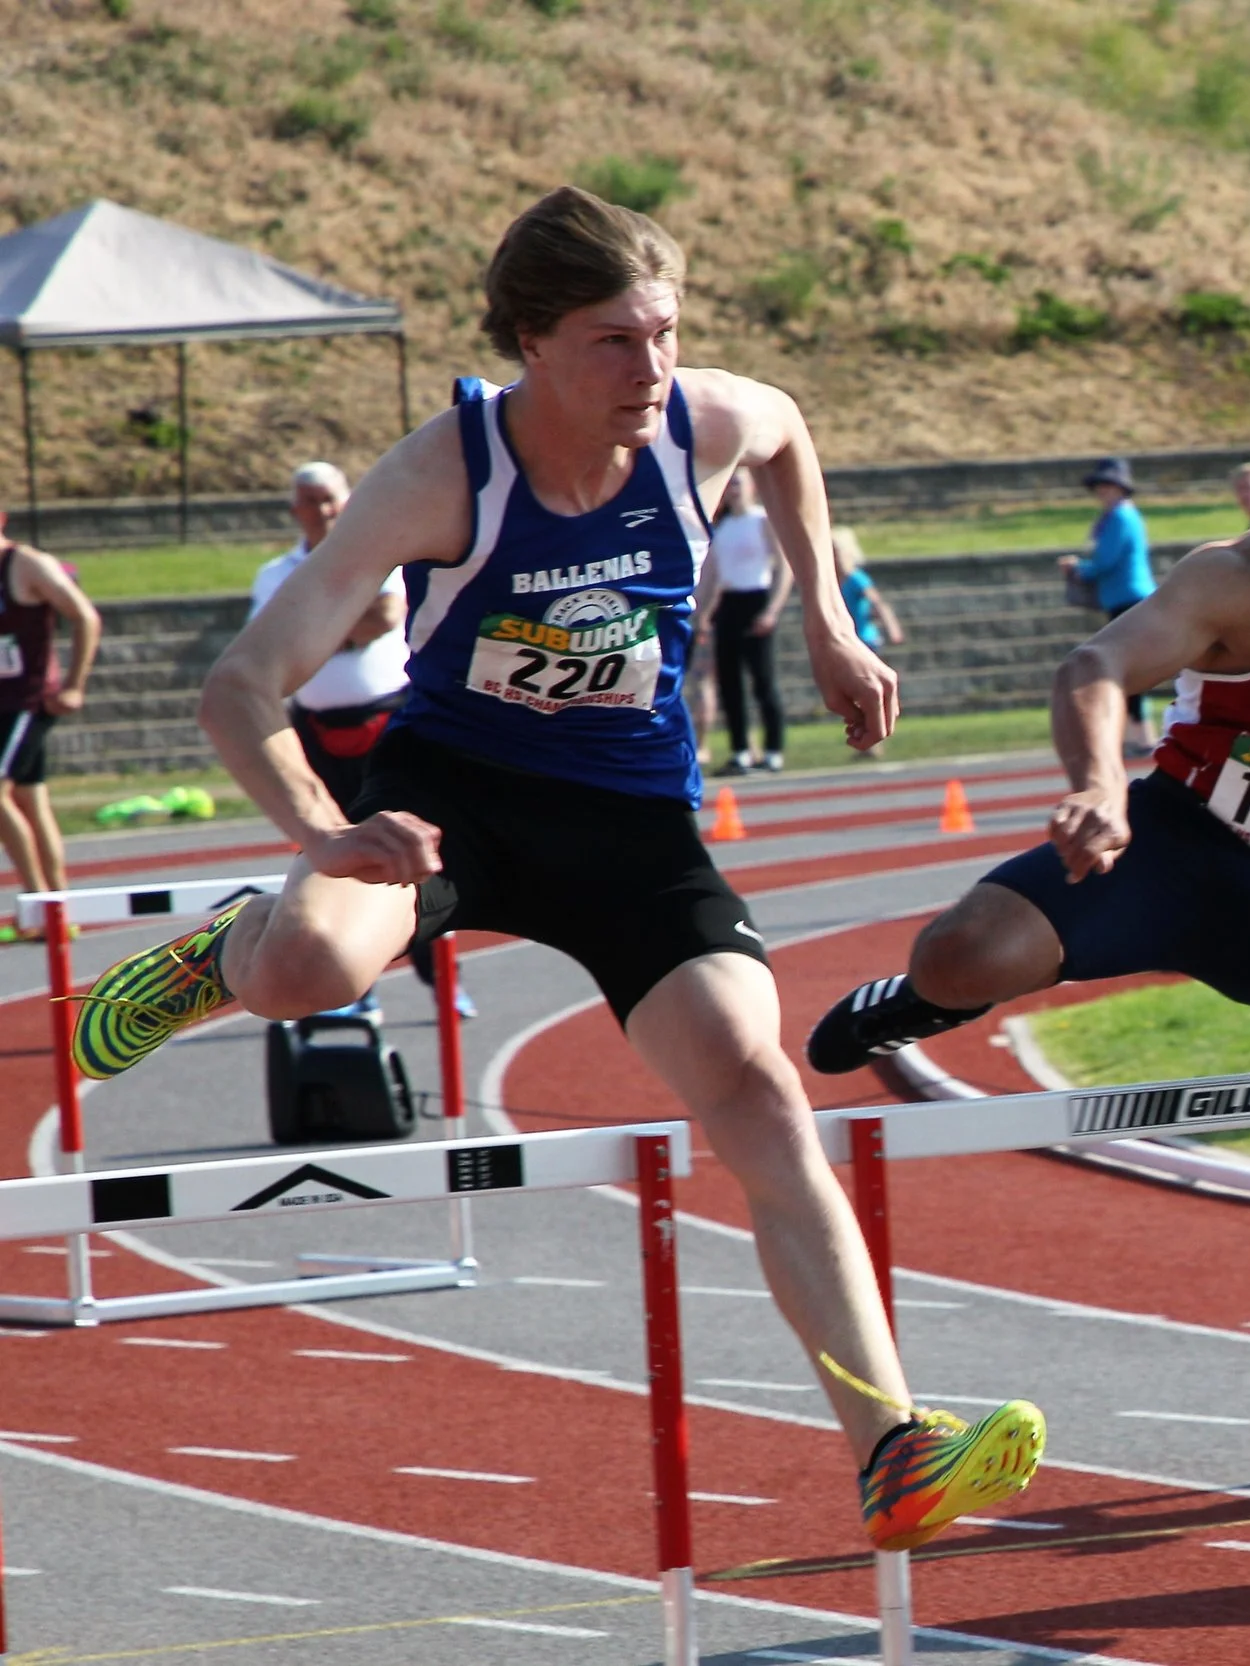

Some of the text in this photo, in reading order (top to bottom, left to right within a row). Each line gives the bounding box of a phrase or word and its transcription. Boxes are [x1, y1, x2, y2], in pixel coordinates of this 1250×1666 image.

[511, 550, 653, 594] BALLENAS
[493, 608, 649, 653] SUBWAY
[508, 648, 627, 700] 220
